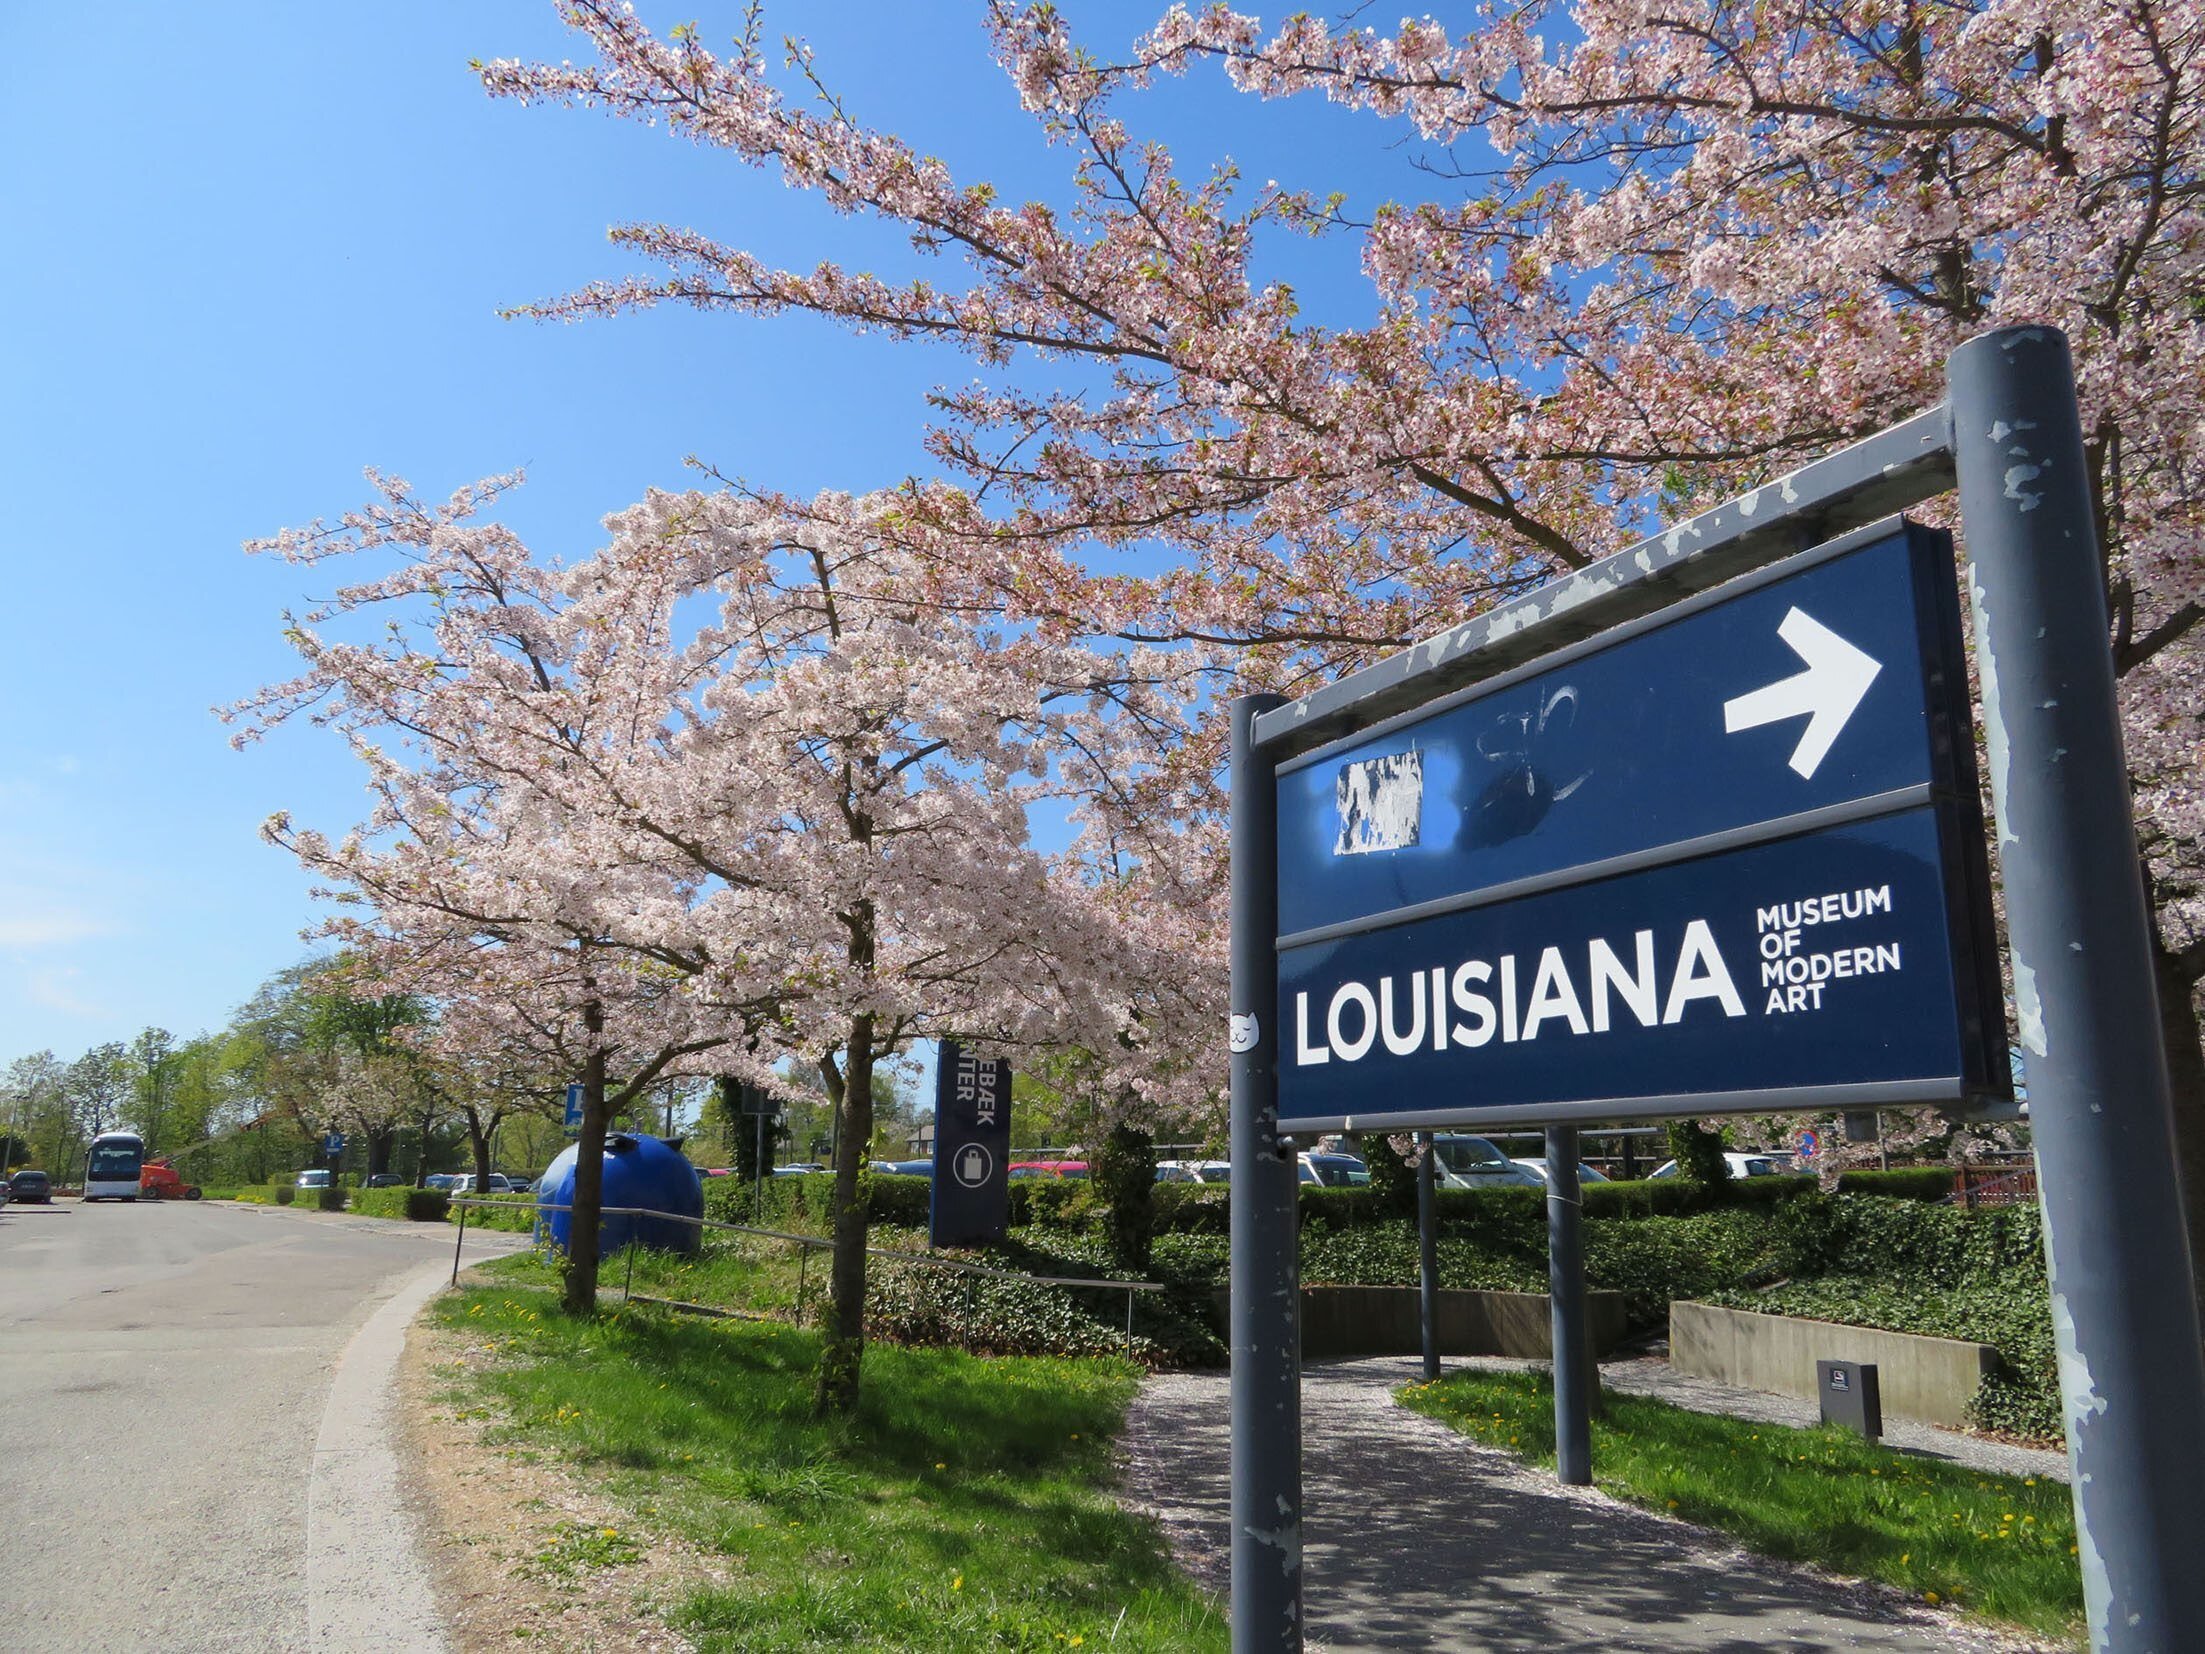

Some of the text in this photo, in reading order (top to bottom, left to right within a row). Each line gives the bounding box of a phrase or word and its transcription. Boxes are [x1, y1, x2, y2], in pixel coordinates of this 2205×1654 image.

[1757, 885, 1891, 933] MUSEUM
[1760, 929, 1801, 959] OF
[1761, 942, 1900, 987] MODERN
[1296, 919, 1746, 1066] LOUISIANA
[1765, 982, 1826, 1015] ART
[957, 1045, 976, 1100] NTER
[977, 1060, 997, 1125] EBÆK
